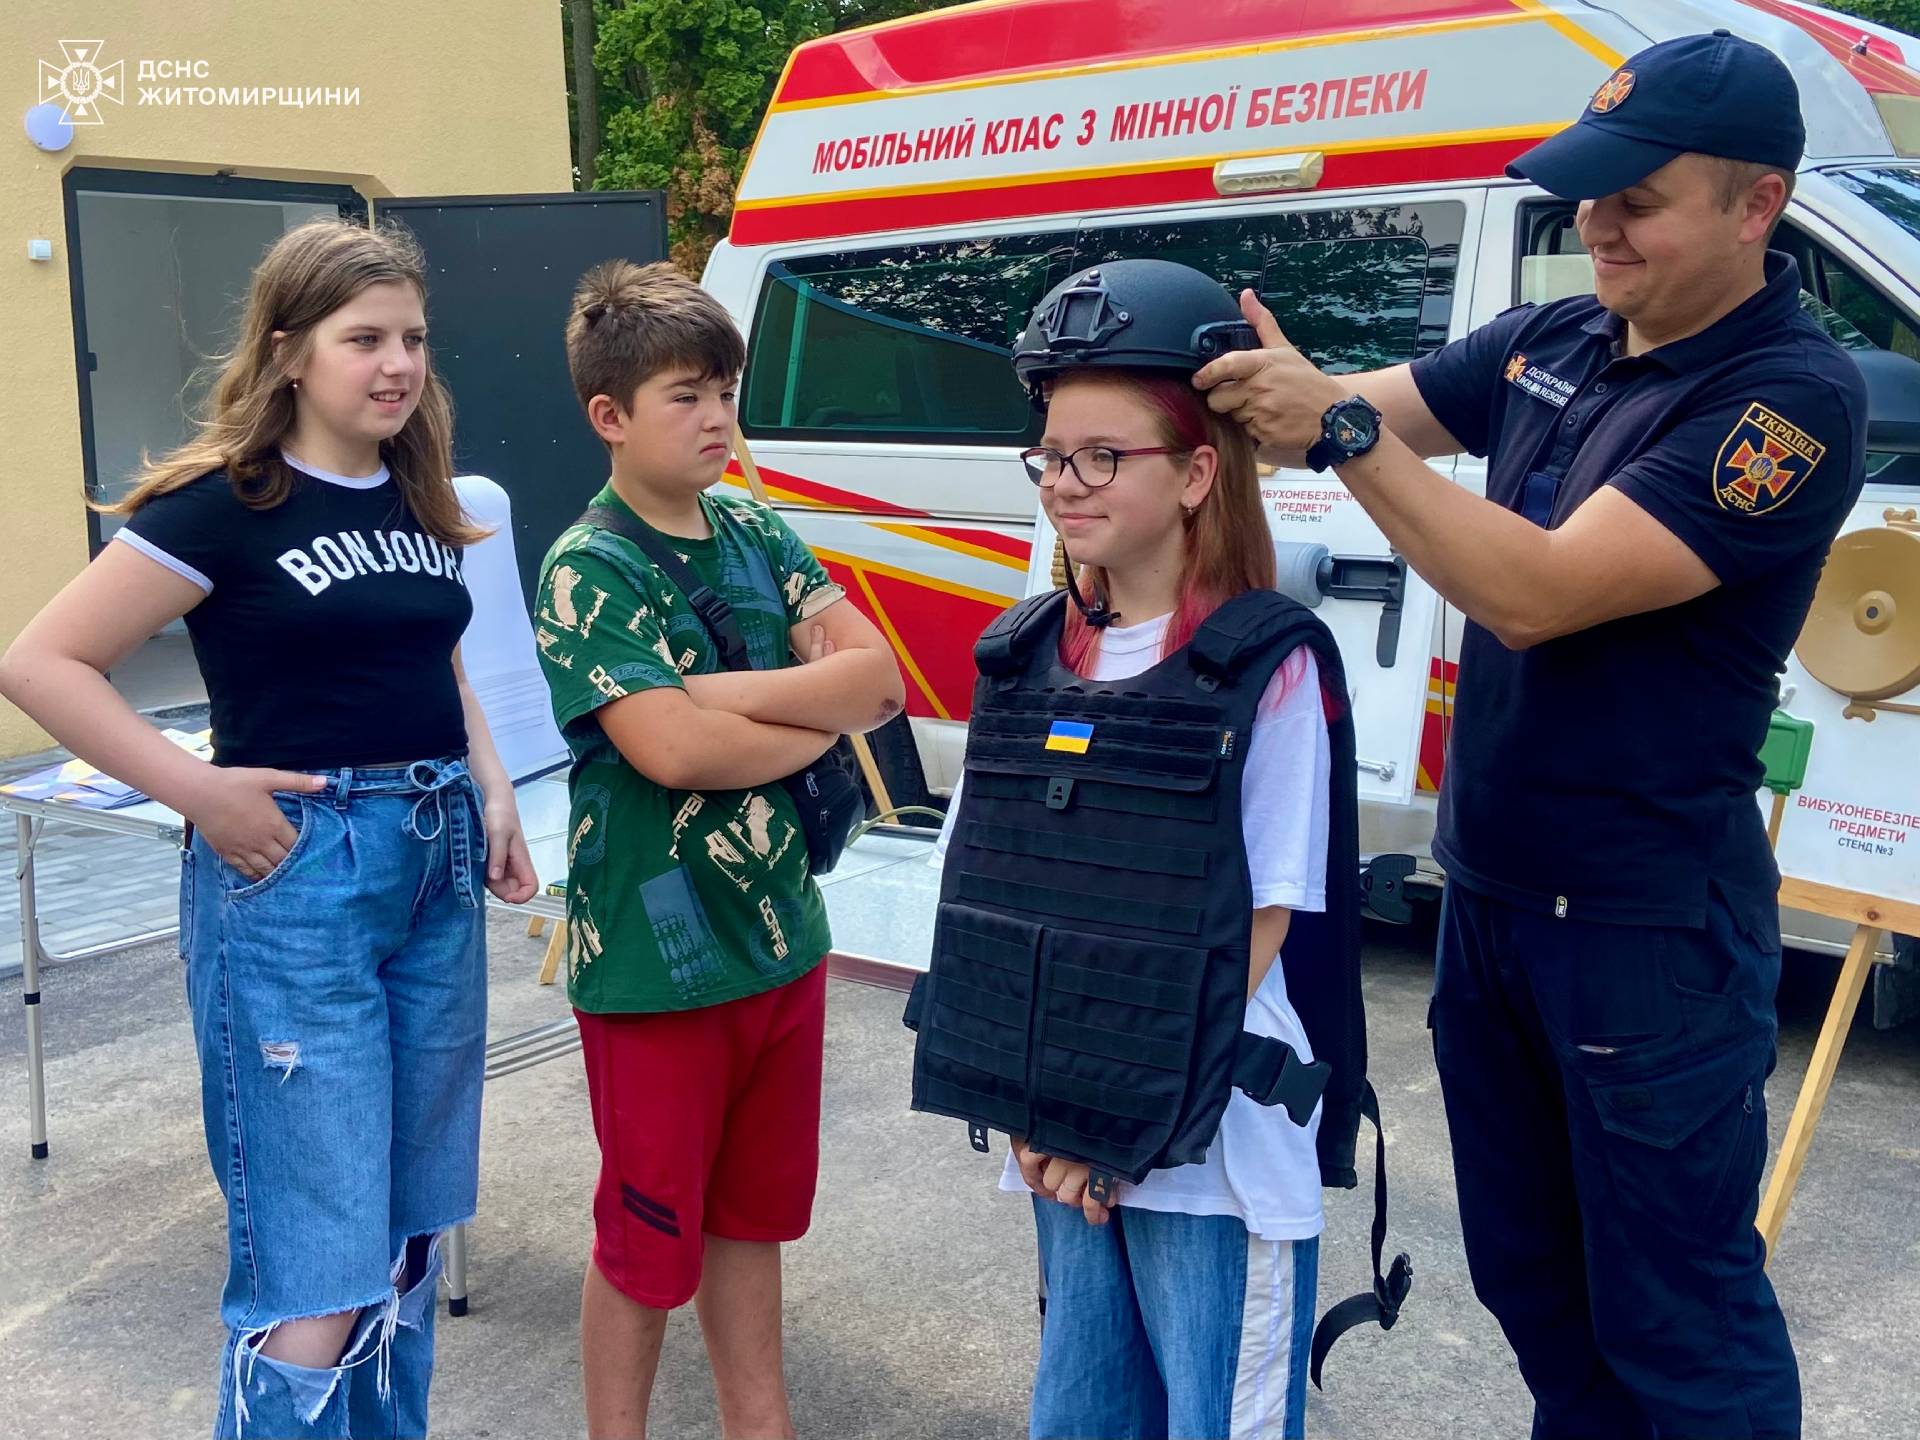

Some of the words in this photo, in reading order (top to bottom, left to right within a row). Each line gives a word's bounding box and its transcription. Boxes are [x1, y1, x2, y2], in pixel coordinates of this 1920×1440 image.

[812, 117, 976, 174] МОБІЛЬНИЙ
[982, 113, 1064, 156] КЛАС
[1110, 85, 1241, 142] МІННОЇ
[1246, 69, 1428, 129] БЕЗПЕКИ
[1755, 411, 1817, 458] УКРАЇНА
[1274, 502, 1332, 514] ПРЕДМЕТИ
[1719, 486, 1756, 512] ДСНС
[1280, 513, 1307, 523] СТЕНД
[1309, 514, 1322, 523] №2
[276, 529, 465, 597] BONJOUR
[1829, 818, 1906, 843] ПРЕДМЕТИ
[1838, 837, 1873, 854] СТЕНД
[1875, 845, 1894, 856] №3
